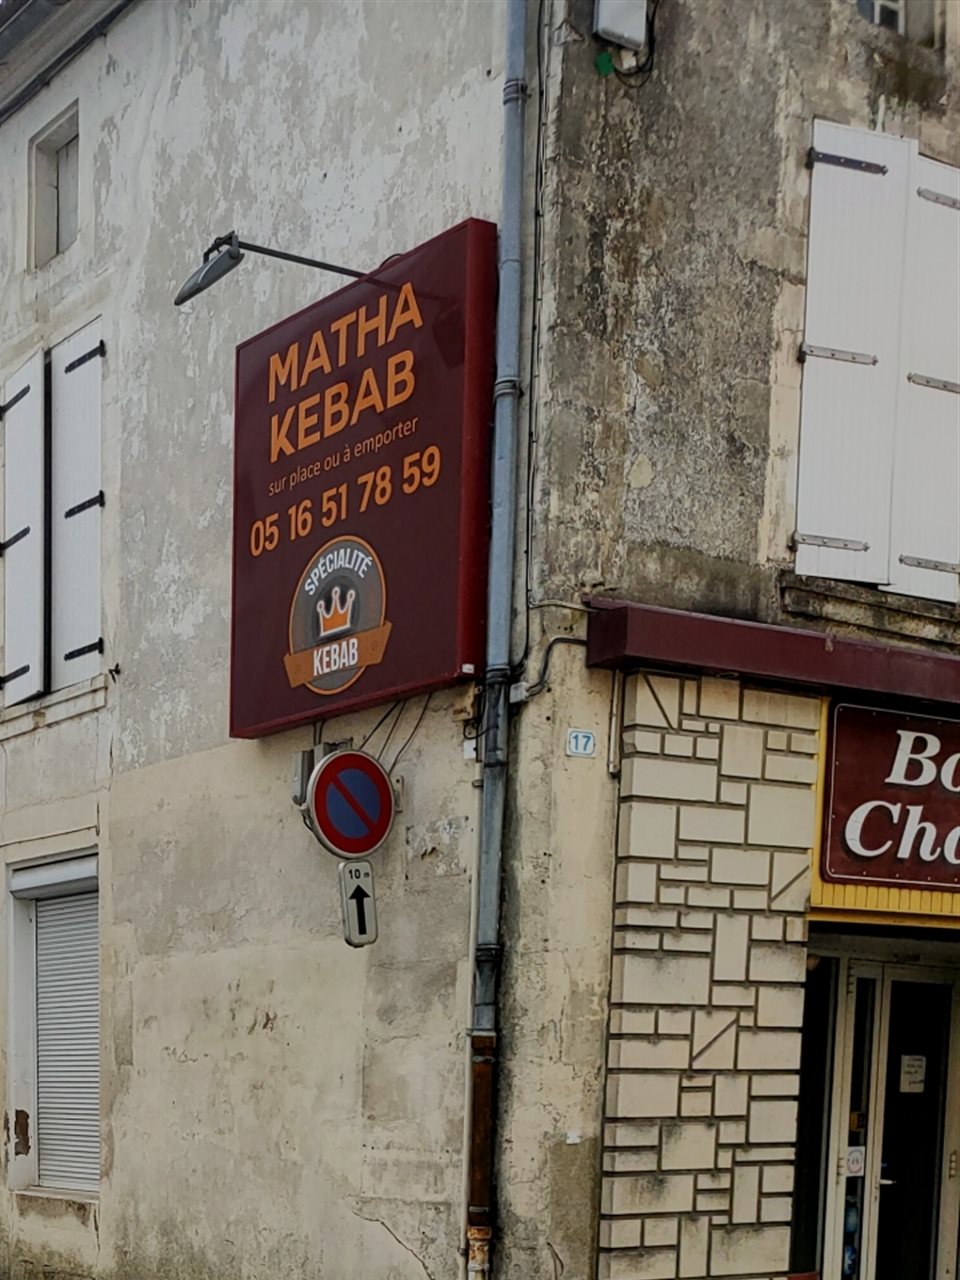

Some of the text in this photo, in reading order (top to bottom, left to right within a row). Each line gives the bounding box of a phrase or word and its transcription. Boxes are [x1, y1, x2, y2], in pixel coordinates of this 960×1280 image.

[268, 282, 423, 403] MATHA
[270, 350, 416, 463] KEBAB
[269, 417, 419, 497] sur place ou à emporter
[250, 445, 441, 556] 05 16 51 78 59
[304, 548, 373, 596] SPÉCIALITÉ
[313, 637, 358, 677] KEBAB
[572, 734, 591, 752] 17
[348, 868, 361, 880] 10
